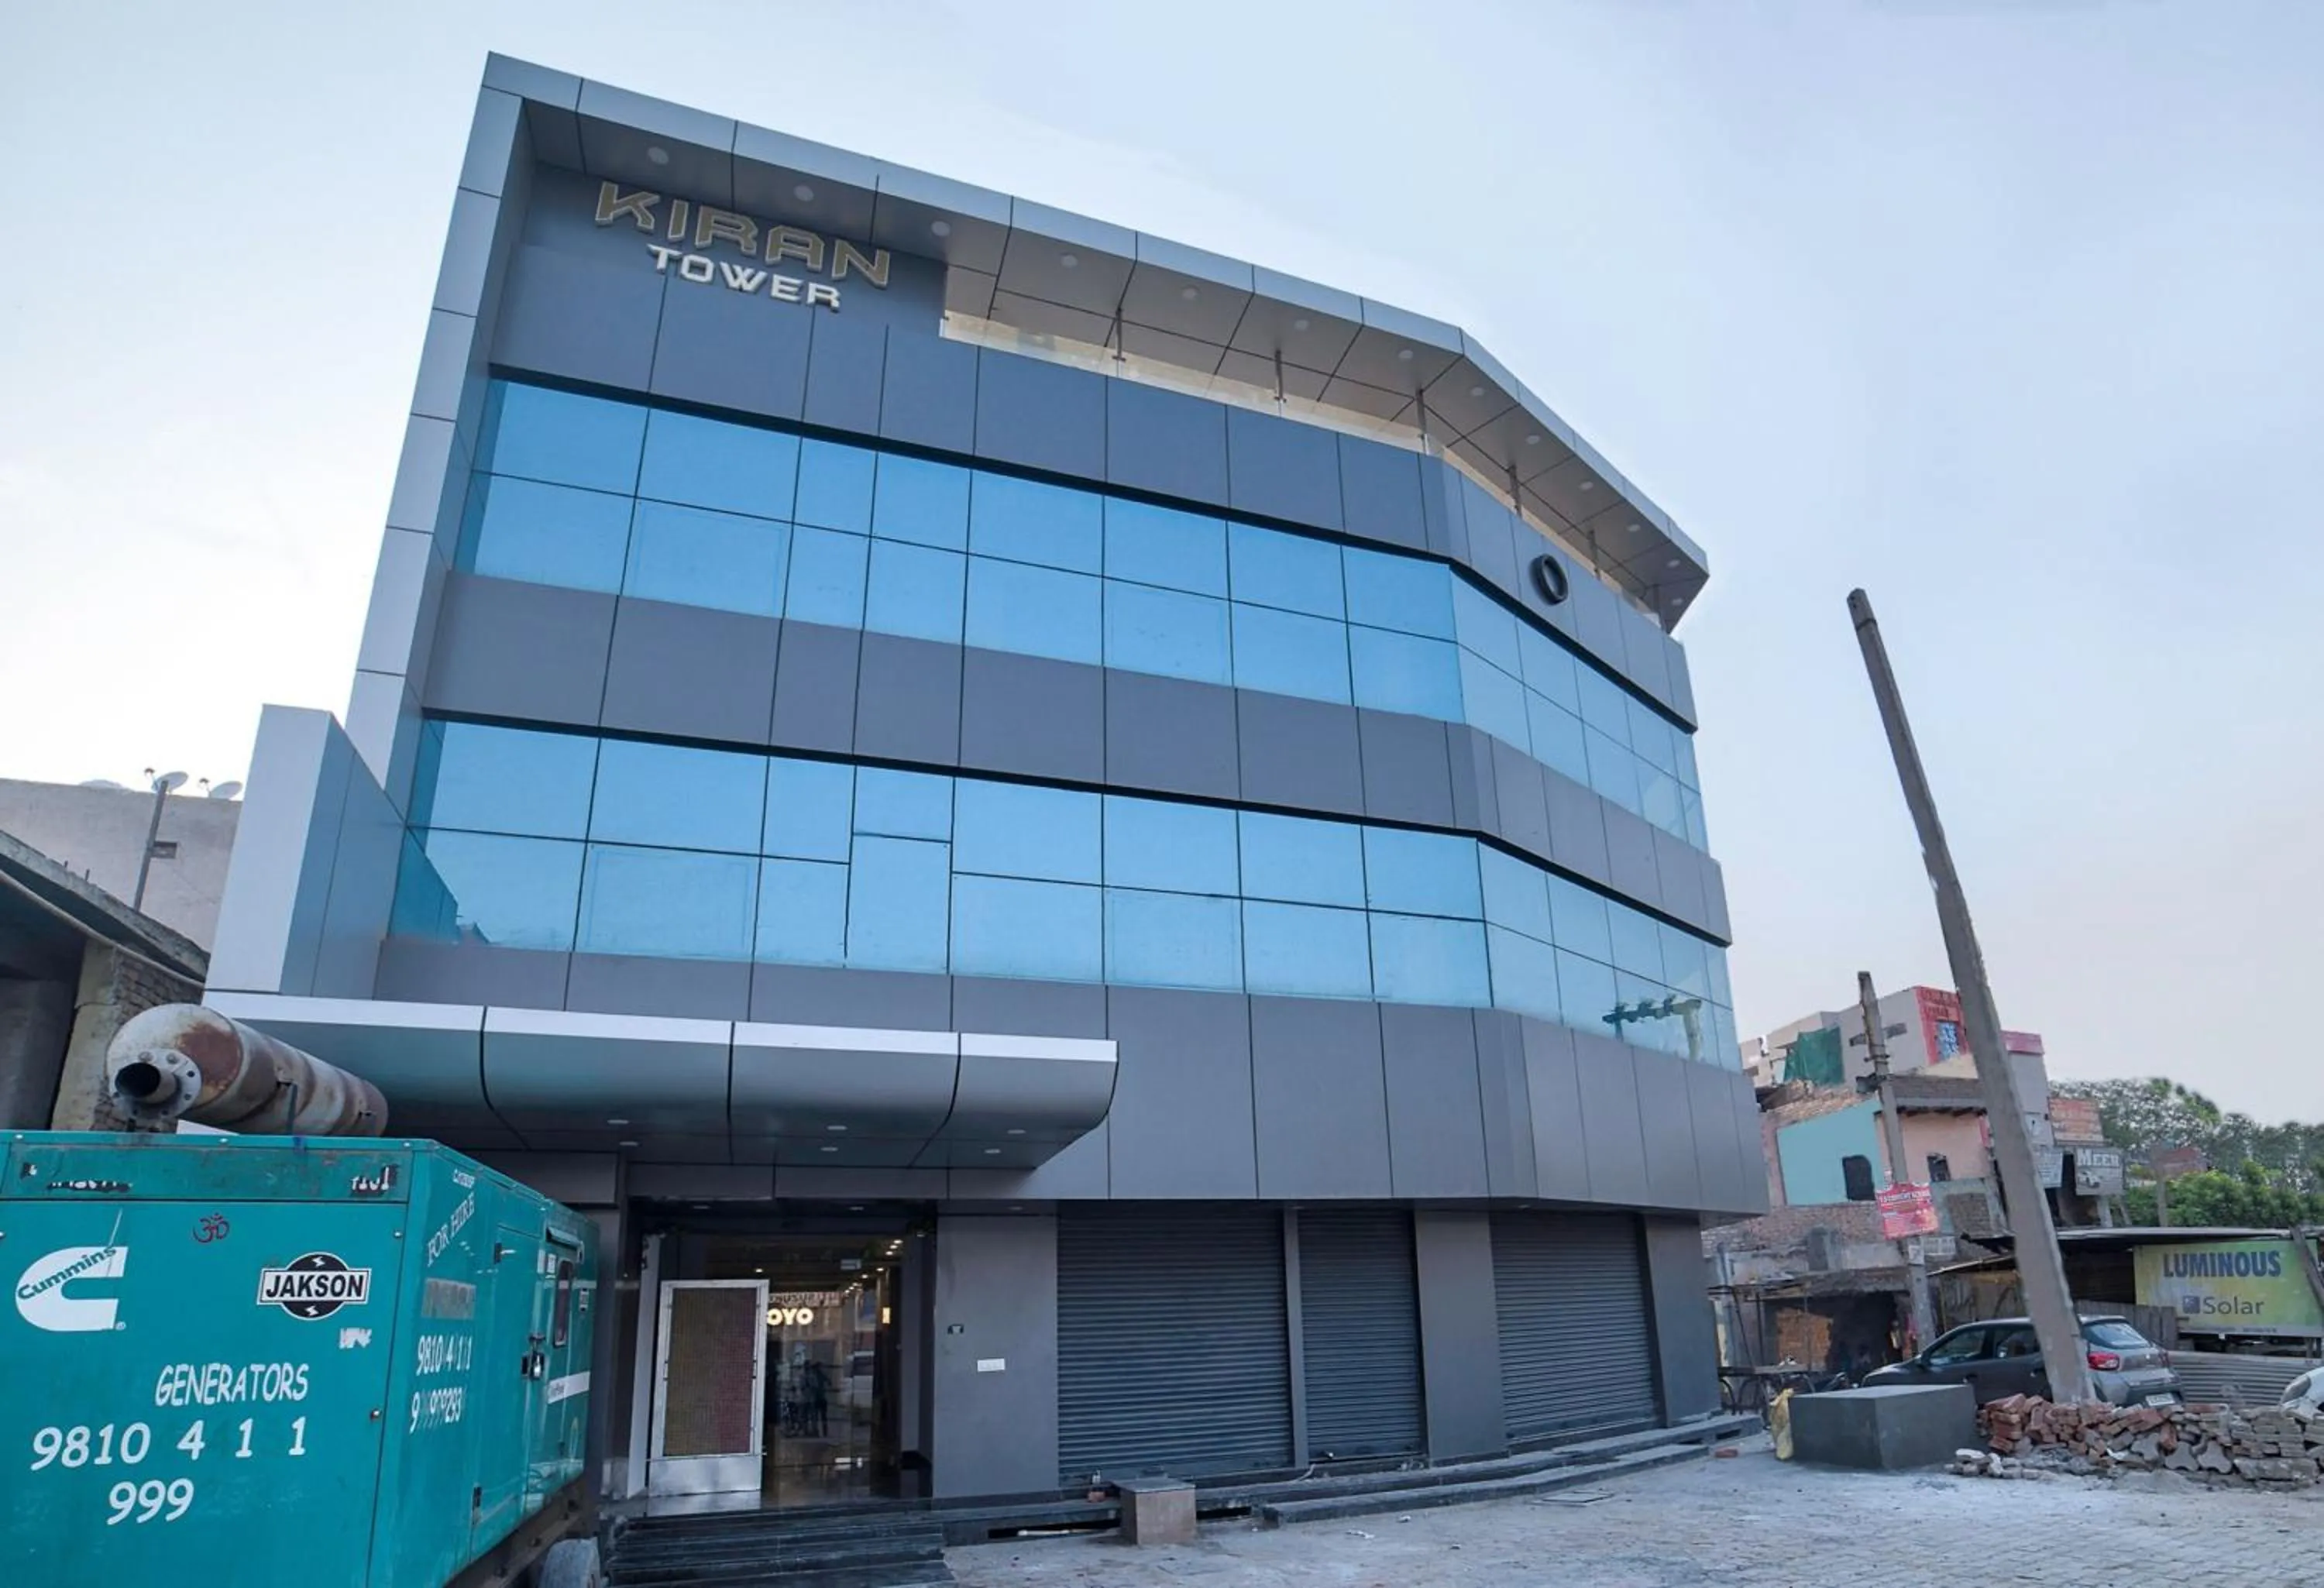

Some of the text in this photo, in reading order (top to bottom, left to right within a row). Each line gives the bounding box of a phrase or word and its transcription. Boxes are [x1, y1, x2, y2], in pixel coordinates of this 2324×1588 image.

[595, 180, 891, 289] KIRAN
[647, 243, 841, 311] TOWER
[426, 1224, 449, 1267] FOR
[2163, 1250, 2281, 1277] LUMINOUS
[17, 1244, 118, 1301] Cummins
[265, 1274, 365, 1298] JAKSON
[767, 1308, 813, 1325] OYO
[2202, 1296, 2265, 1315] Solar
[155, 1363, 309, 1406] GENERATORS
[30, 1421, 151, 1471] 9810
[106, 1477, 194, 1525] 999
